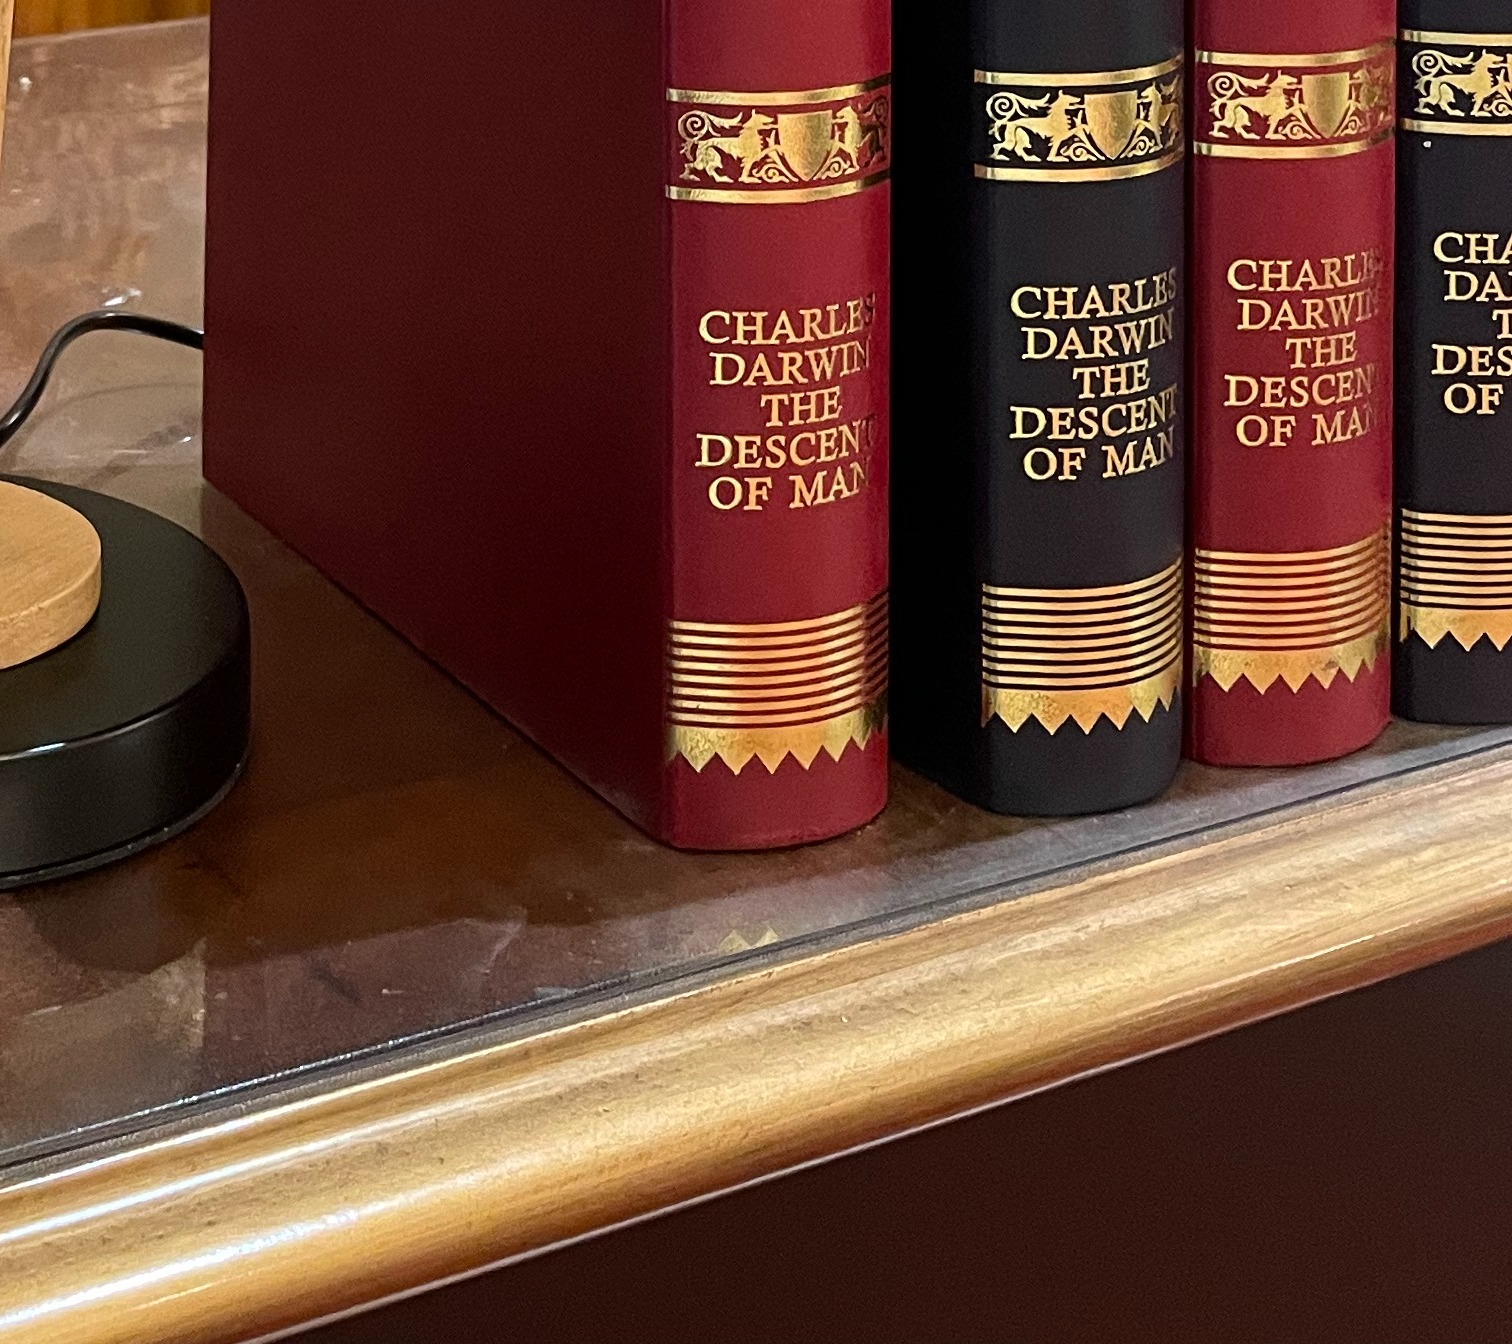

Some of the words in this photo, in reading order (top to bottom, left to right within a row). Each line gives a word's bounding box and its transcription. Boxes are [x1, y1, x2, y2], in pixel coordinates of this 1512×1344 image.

[1009, 266, 1177, 320] CHARLES
[1020, 306, 1176, 360] DARWIN
[1284, 330, 1358, 370] THE
[708, 334, 872, 387] DARWIN
[1072, 357, 1151, 400] THE
[759, 385, 843, 428] THE
[1008, 383, 1178, 440] DESCENT
[1443, 382, 1504, 415] OF
[1022, 446, 1087, 481] OF
[1100, 424, 1175, 479] MAN
[1235, 414, 1297, 448] OF
[707, 475, 773, 511] OF
